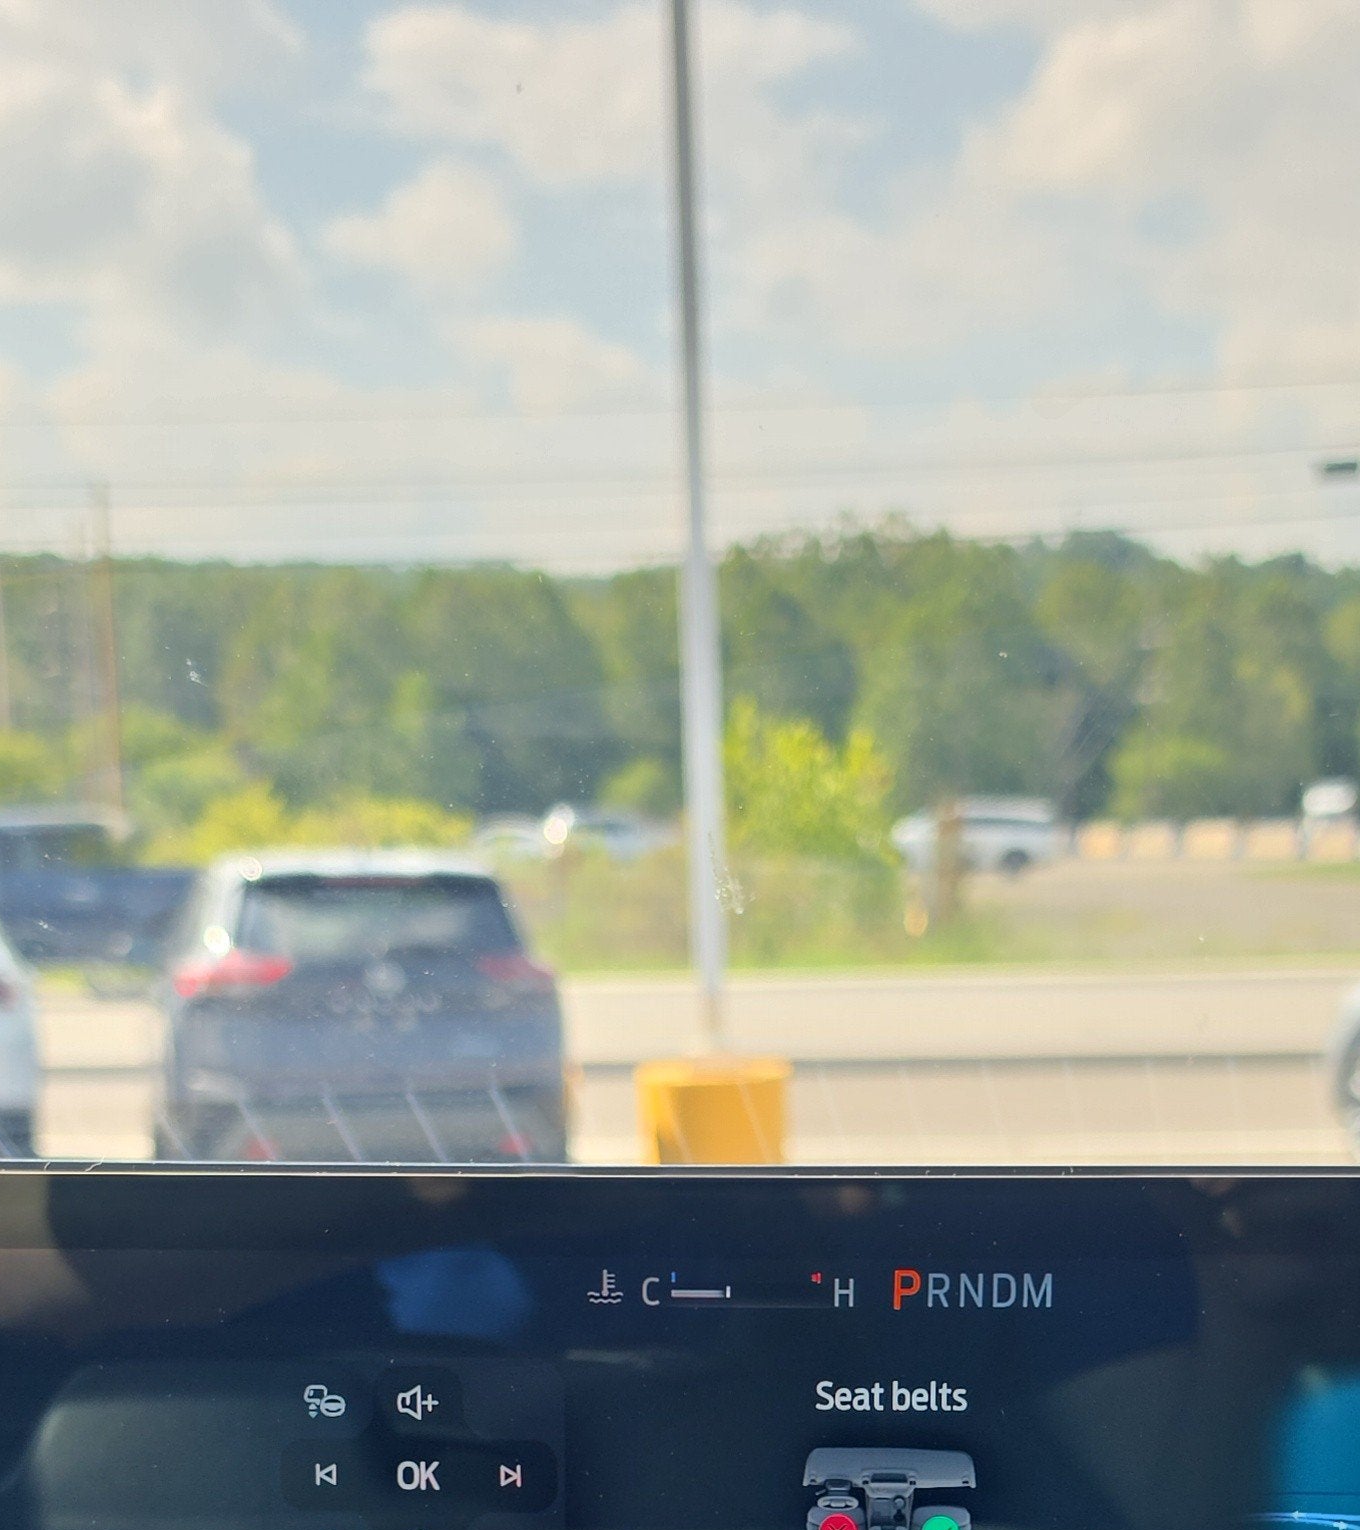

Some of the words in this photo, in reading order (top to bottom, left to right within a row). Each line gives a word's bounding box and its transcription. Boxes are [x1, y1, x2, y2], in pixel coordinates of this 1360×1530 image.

[642, 1277, 660, 1306] C
[833, 1278, 854, 1308] H
[815, 1381, 885, 1412] Seat
[892, 1381, 968, 1412] belts
[396, 1460, 441, 1491] OK
